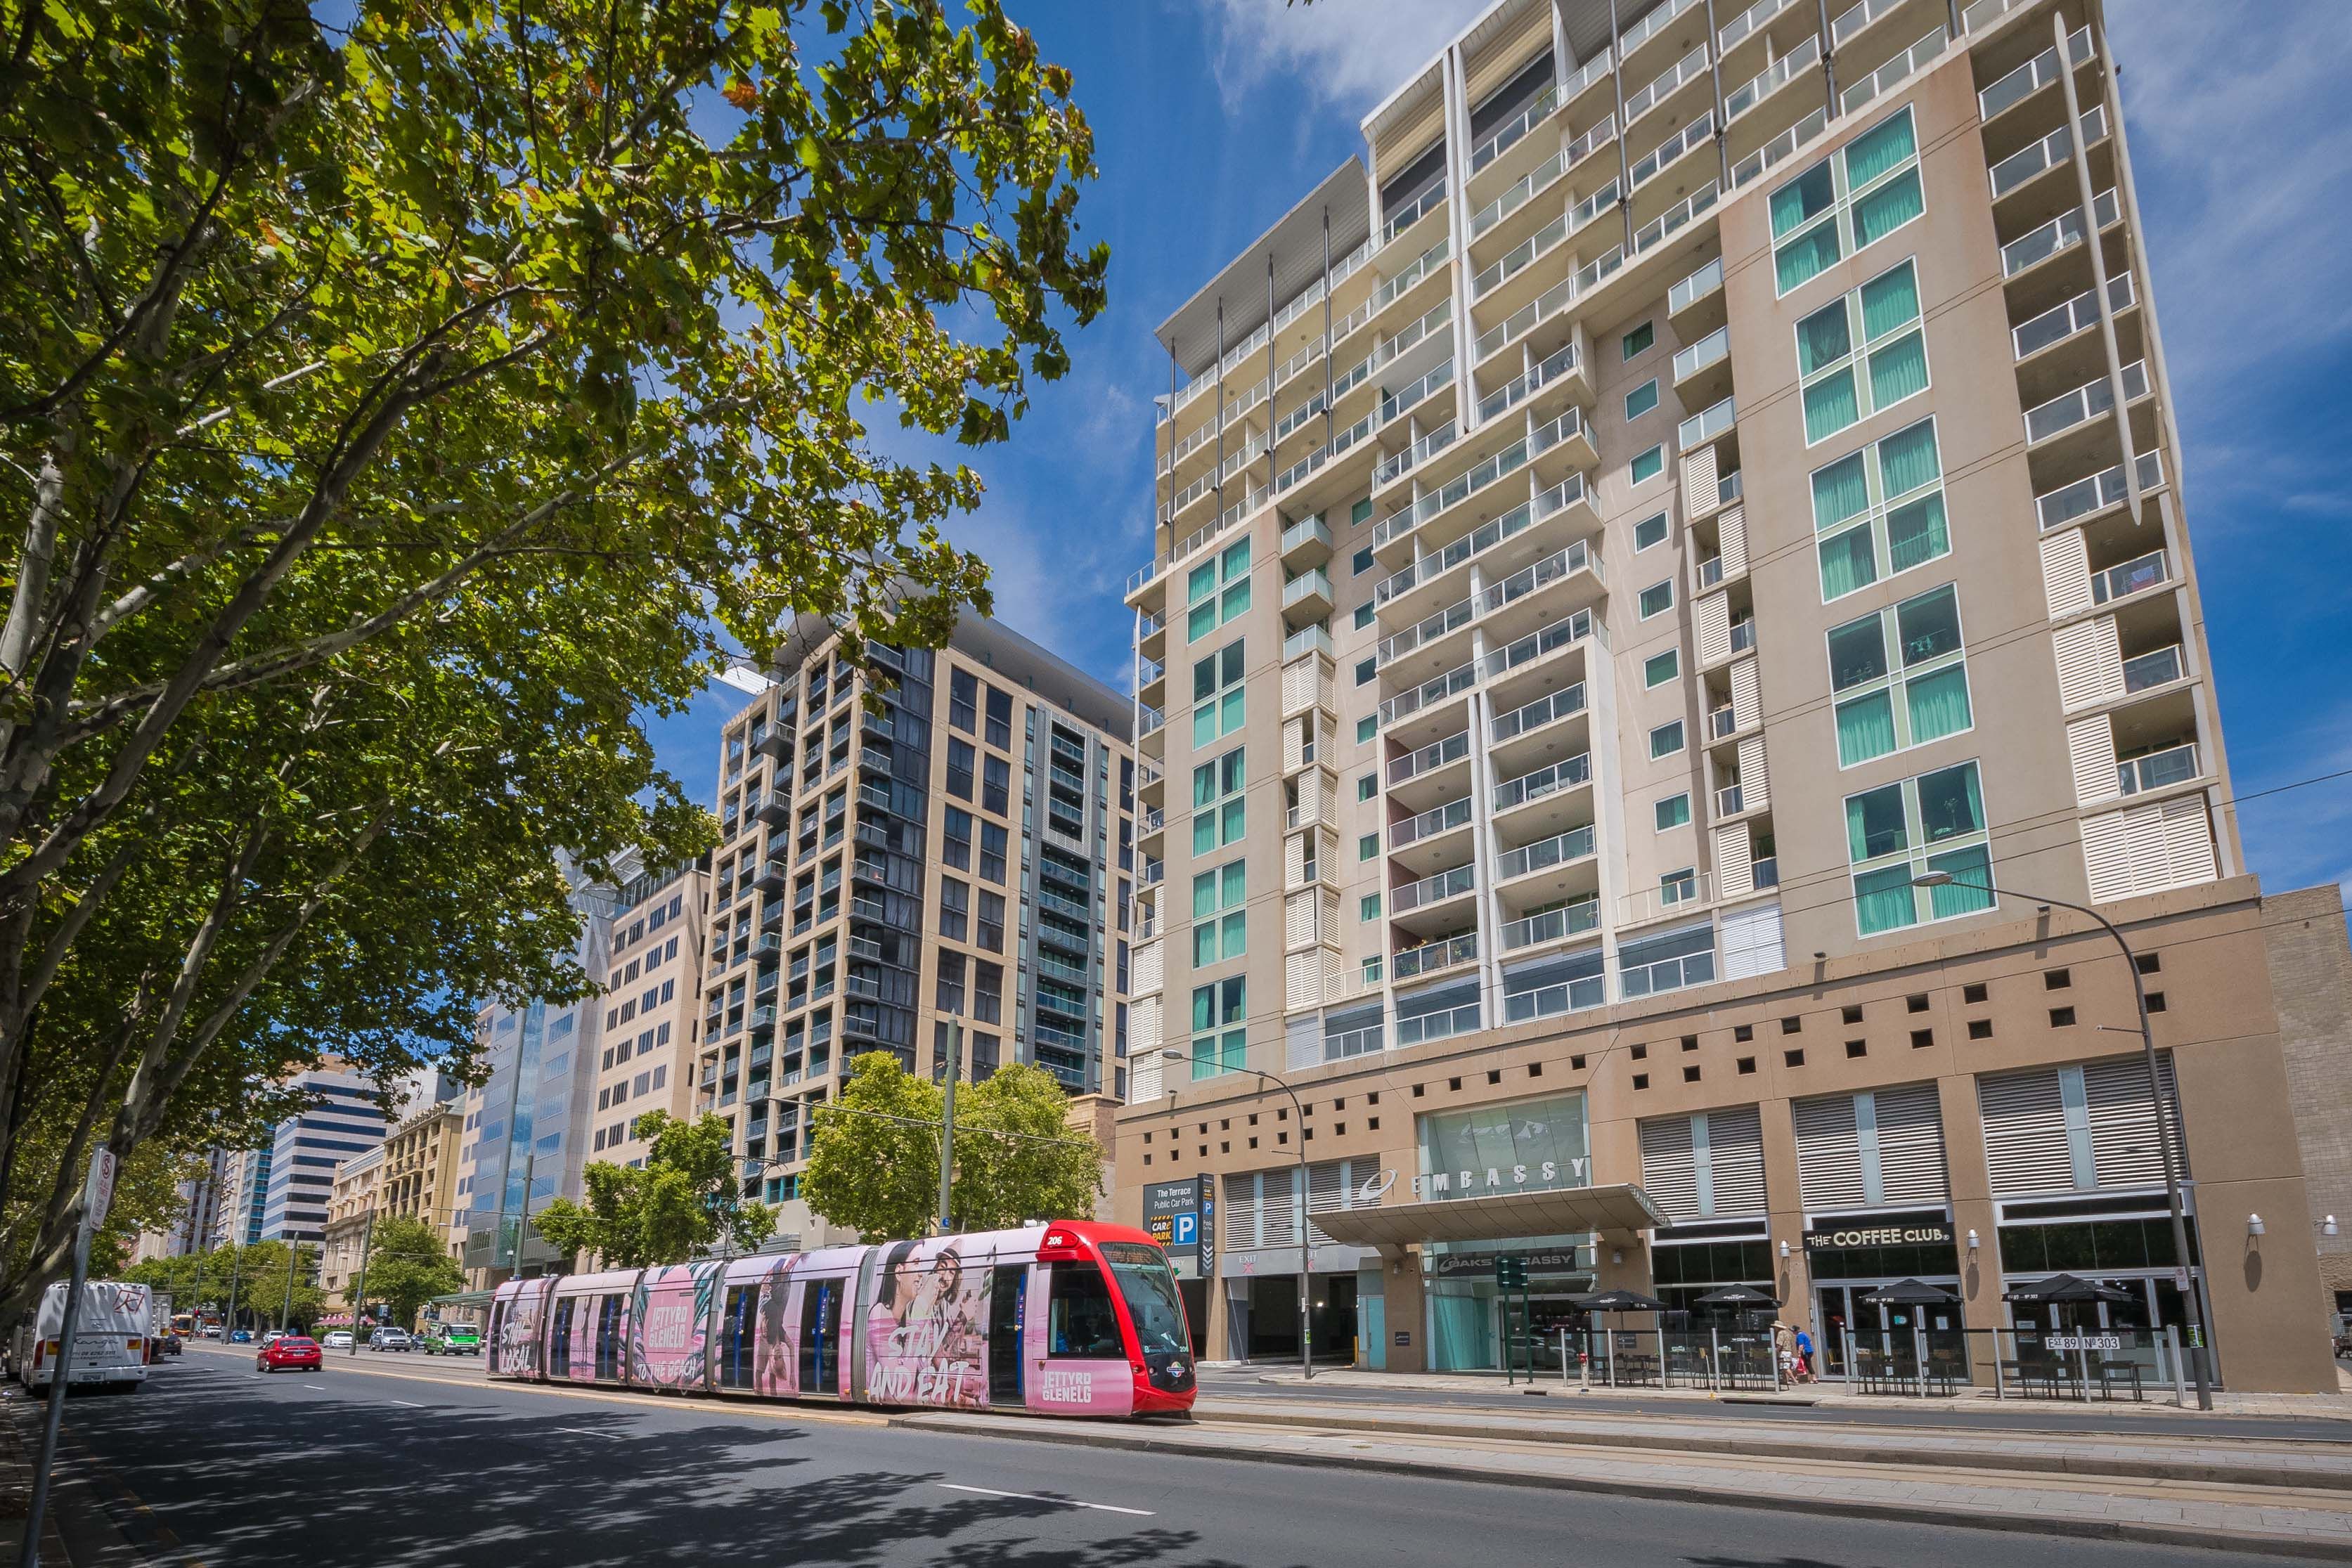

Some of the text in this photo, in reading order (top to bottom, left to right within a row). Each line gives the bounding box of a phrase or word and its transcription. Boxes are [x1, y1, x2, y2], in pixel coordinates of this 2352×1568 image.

[1411, 1158, 1585, 1195] EMBASSY
[1157, 1187, 1191, 1198] The Terrace
[1154, 1198, 1194, 1210] Public Car Park
[1047, 1236, 1063, 1245] 206
[1807, 1229, 1942, 1247] THE COFFEE CLUB
[1239, 1255, 1257, 1263] EXIT
[1298, 1250, 1319, 1259] EIT
[649, 1324, 686, 1348] GLENELG
[888, 1322, 949, 1363] STAY
[2064, 1337, 2076, 1348] 89
[2098, 1337, 2118, 1348] 303
[501, 1344, 531, 1373] LOCAL
[637, 1356, 697, 1380] TO THE BEACH
[870, 1357, 970, 1404] AND EAT
[1042, 1385, 1091, 1404] GLENELG
